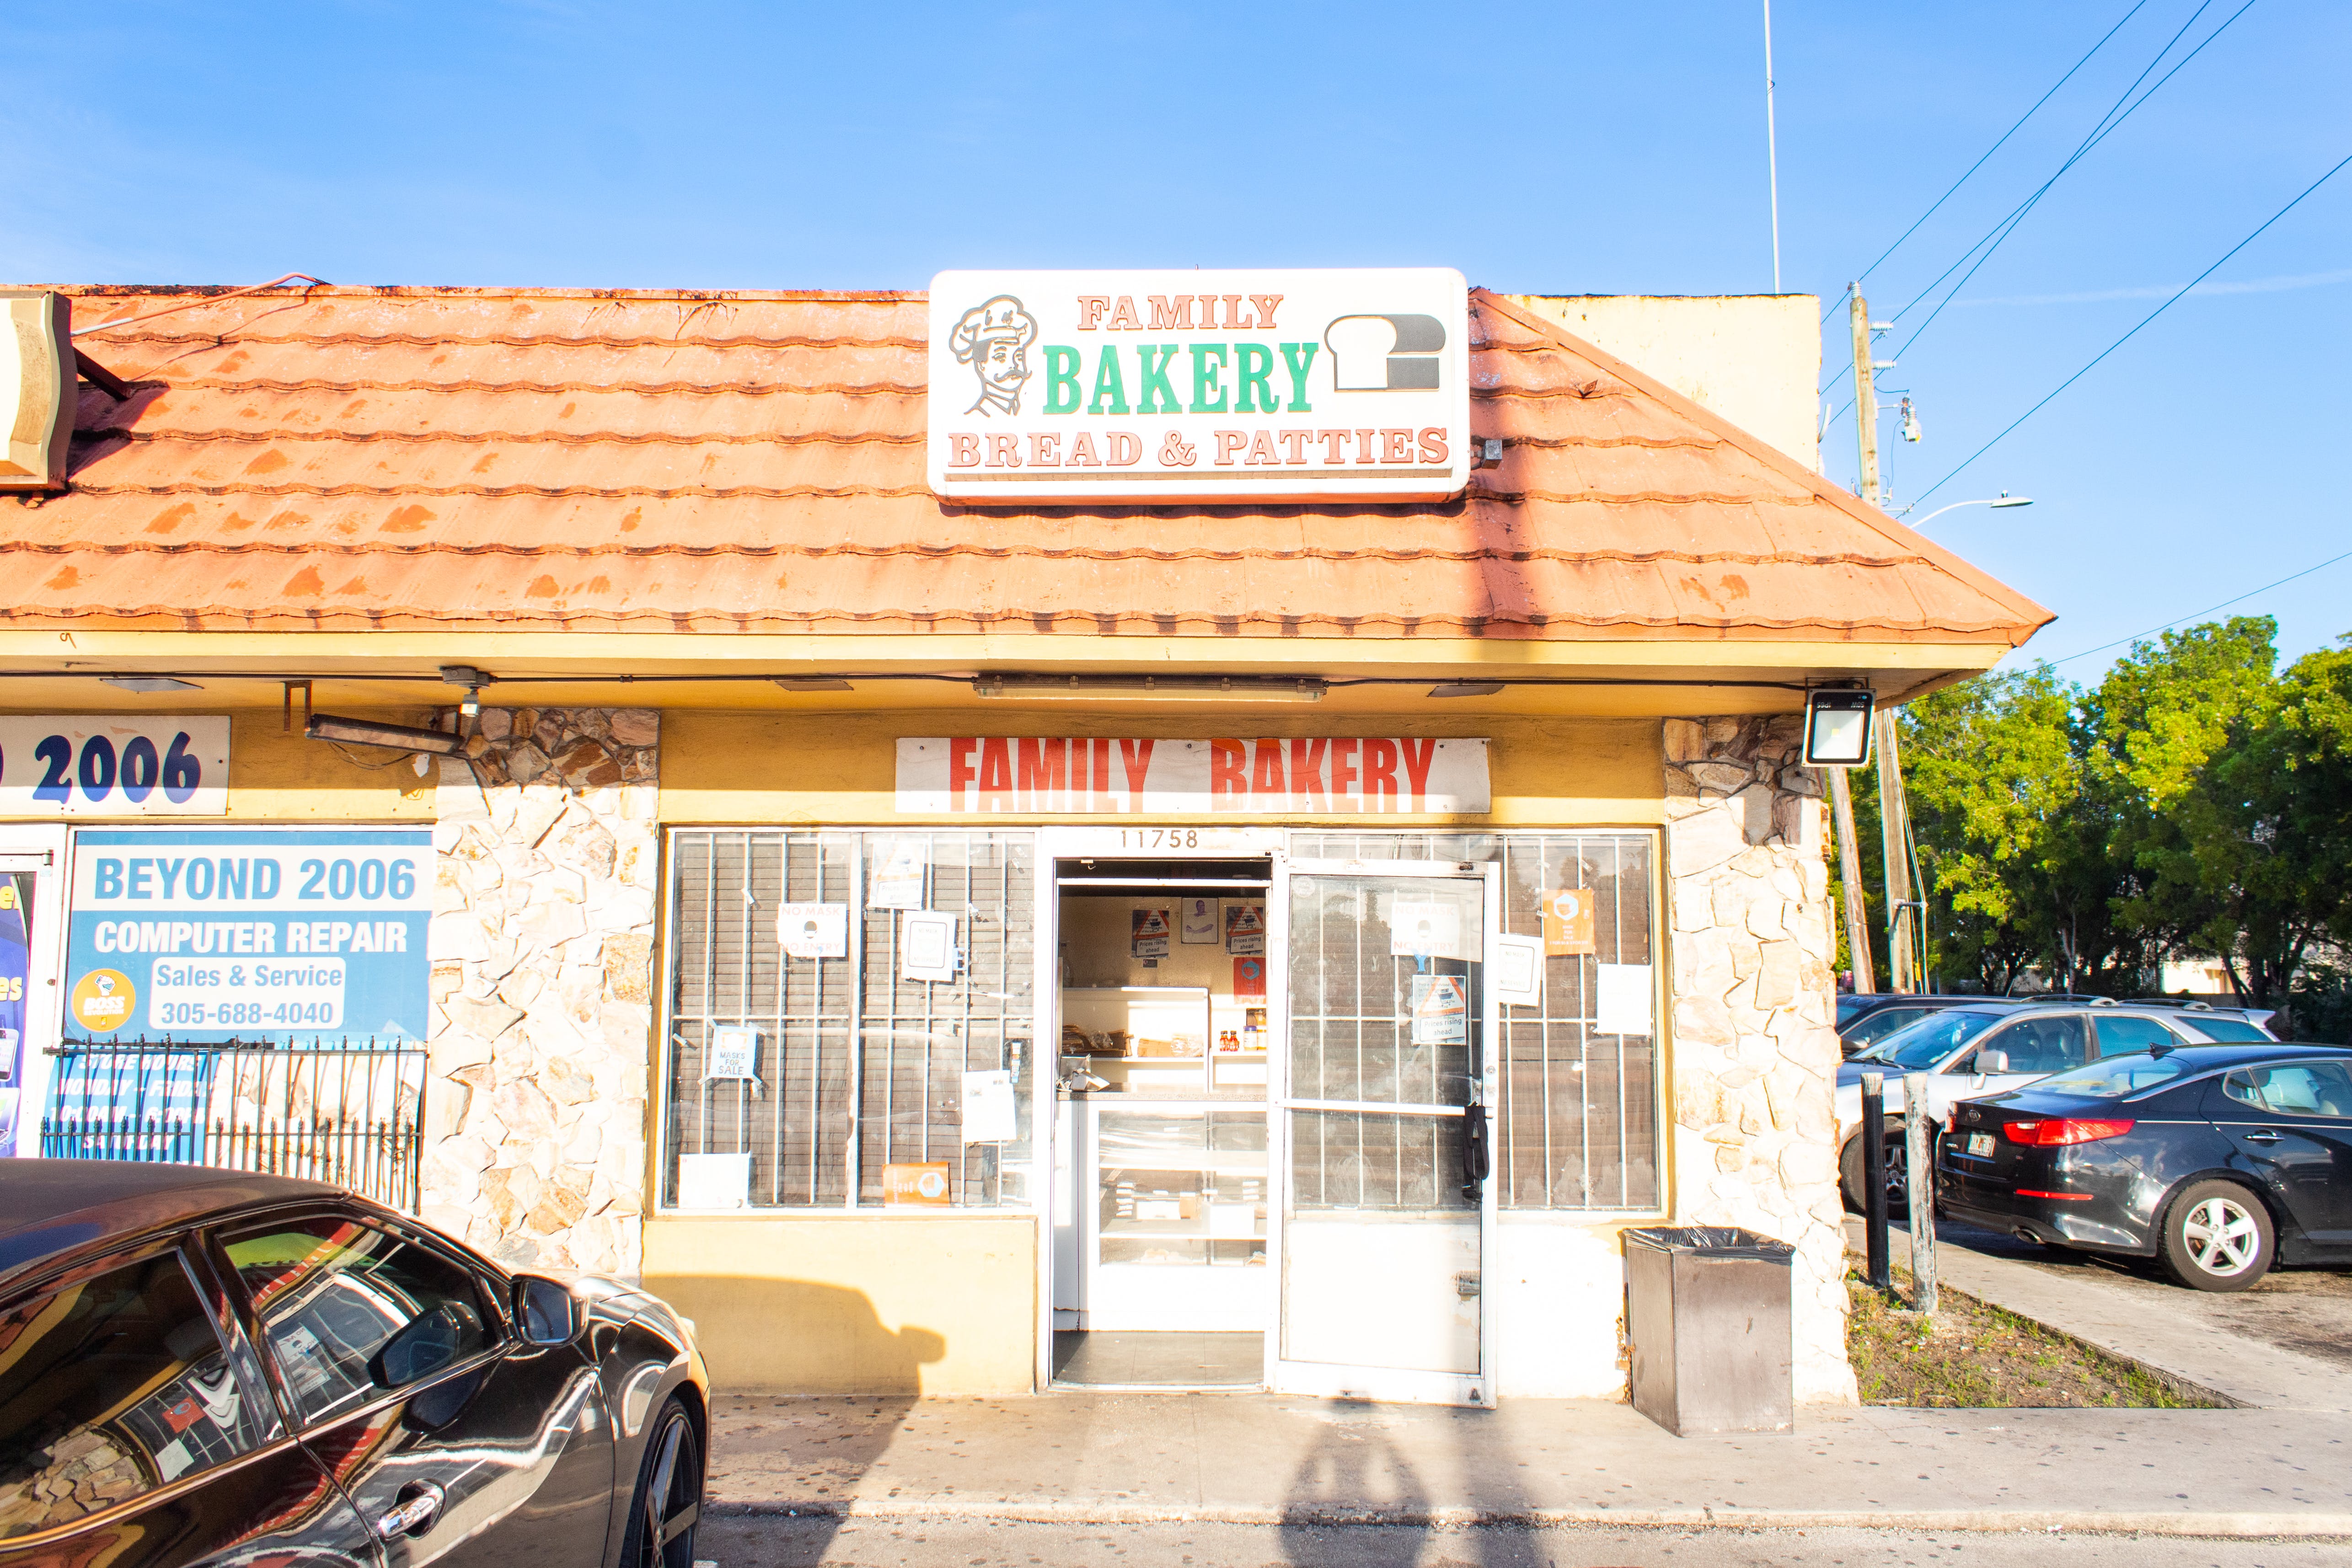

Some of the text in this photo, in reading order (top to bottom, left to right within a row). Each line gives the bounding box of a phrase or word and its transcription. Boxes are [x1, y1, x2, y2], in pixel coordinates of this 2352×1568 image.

[1078, 294, 1283, 330] FAMILY
[1042, 342, 1318, 415] BAKERY
[948, 427, 1448, 468] BREAD & PATTIES
[32, 731, 201, 804] 2006
[950, 738, 1436, 813] FAMILY BAKERY
[1121, 830, 1198, 848] 11758
[94, 858, 416, 900] BEYOND 2006
[782, 906, 841, 916] NO MASK
[94, 921, 407, 953] COMPUTER REPAIR
[1393, 941, 1454, 951] NO ENTRY
[157, 964, 343, 987] Sales & Service
[84, 996, 125, 1010] BOSS
[161, 1002, 333, 1025] 305-688-4040
[139, 1054, 202, 1071] HOURS
[718, 1065, 744, 1075] SALE
